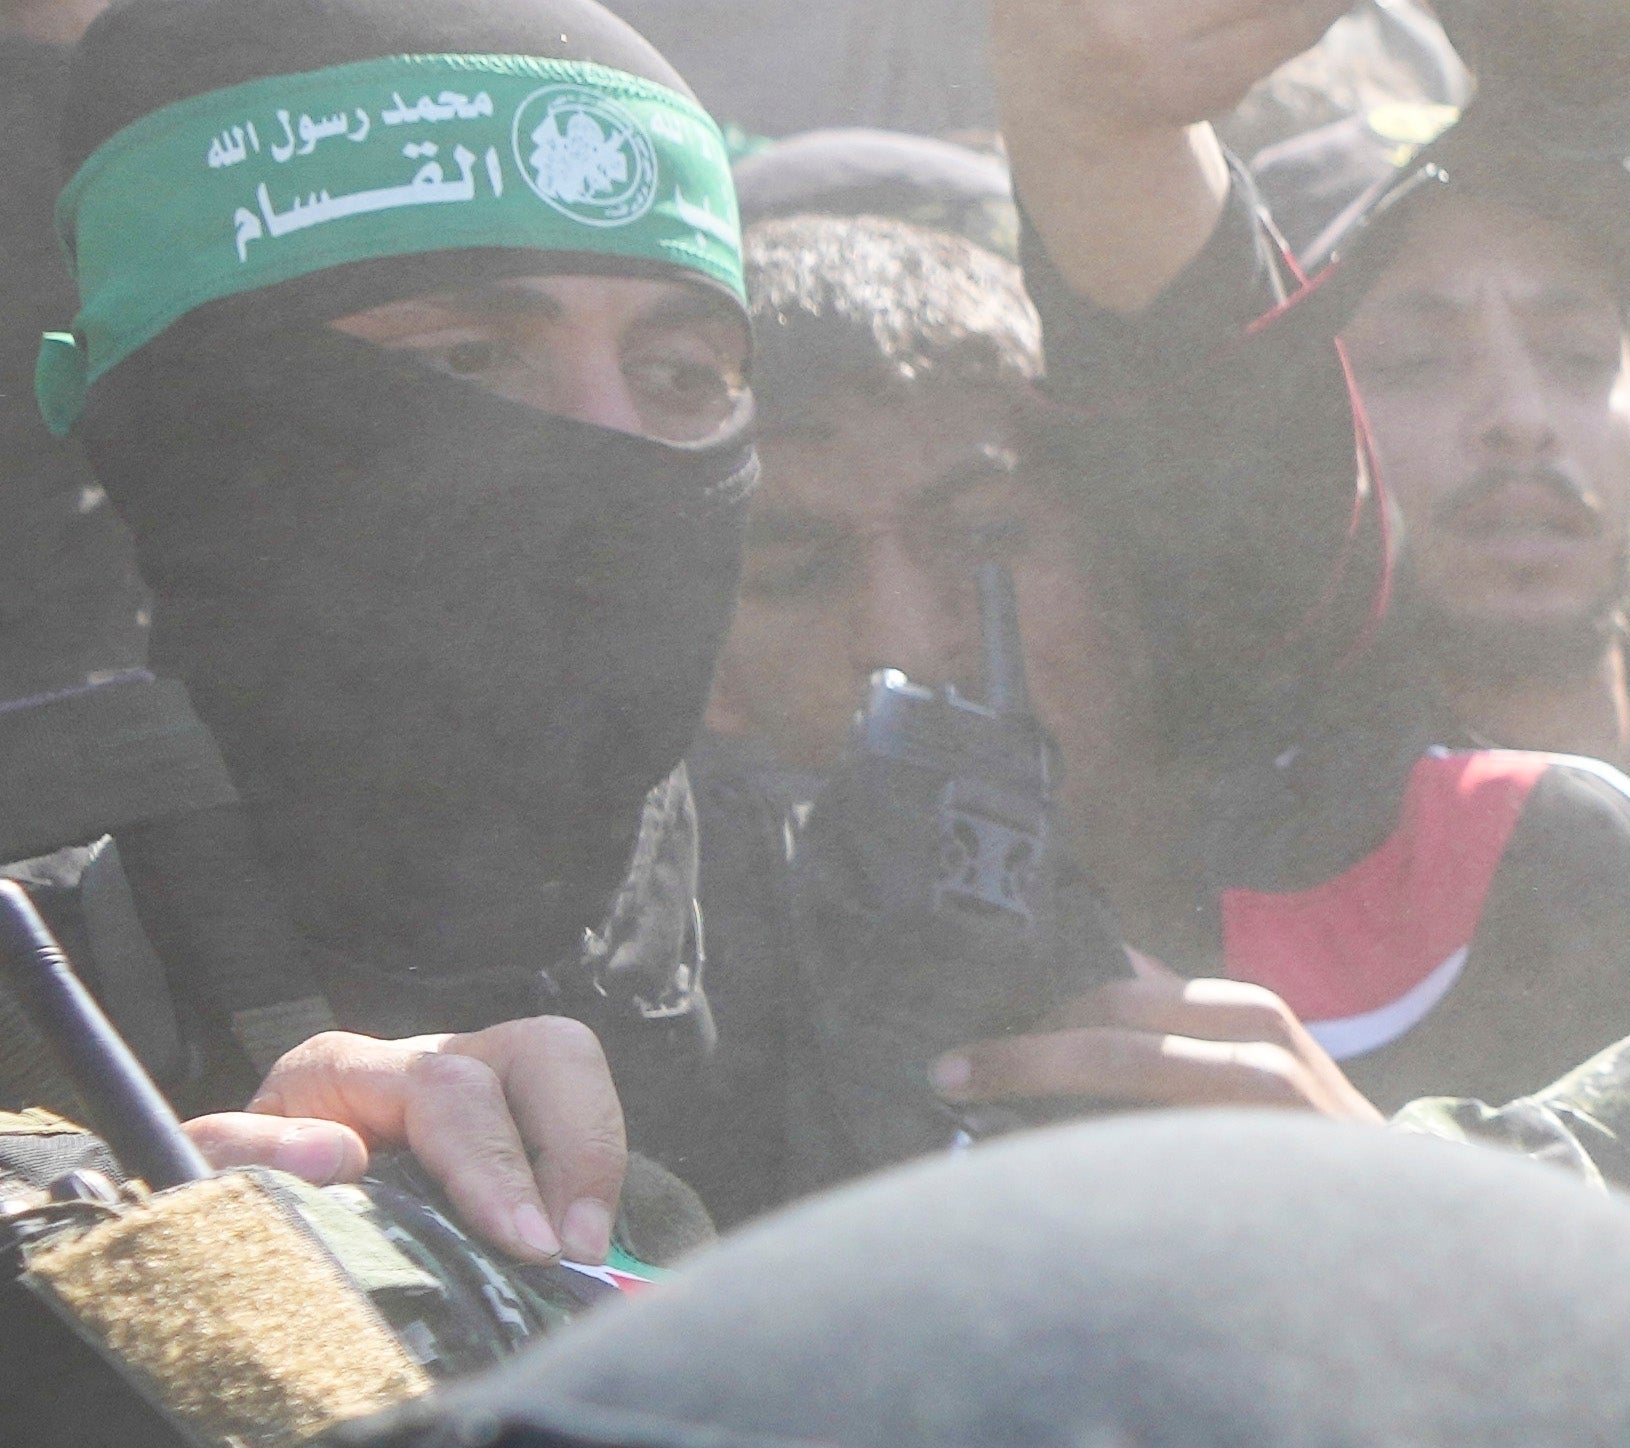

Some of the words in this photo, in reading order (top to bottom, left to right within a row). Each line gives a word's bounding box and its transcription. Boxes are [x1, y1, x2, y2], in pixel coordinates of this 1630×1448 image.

[381, 91, 495, 126] محمد
[207, 120, 261, 168] الله
[270, 107, 372, 164] رسول
[233, 140, 504, 264] القسام
